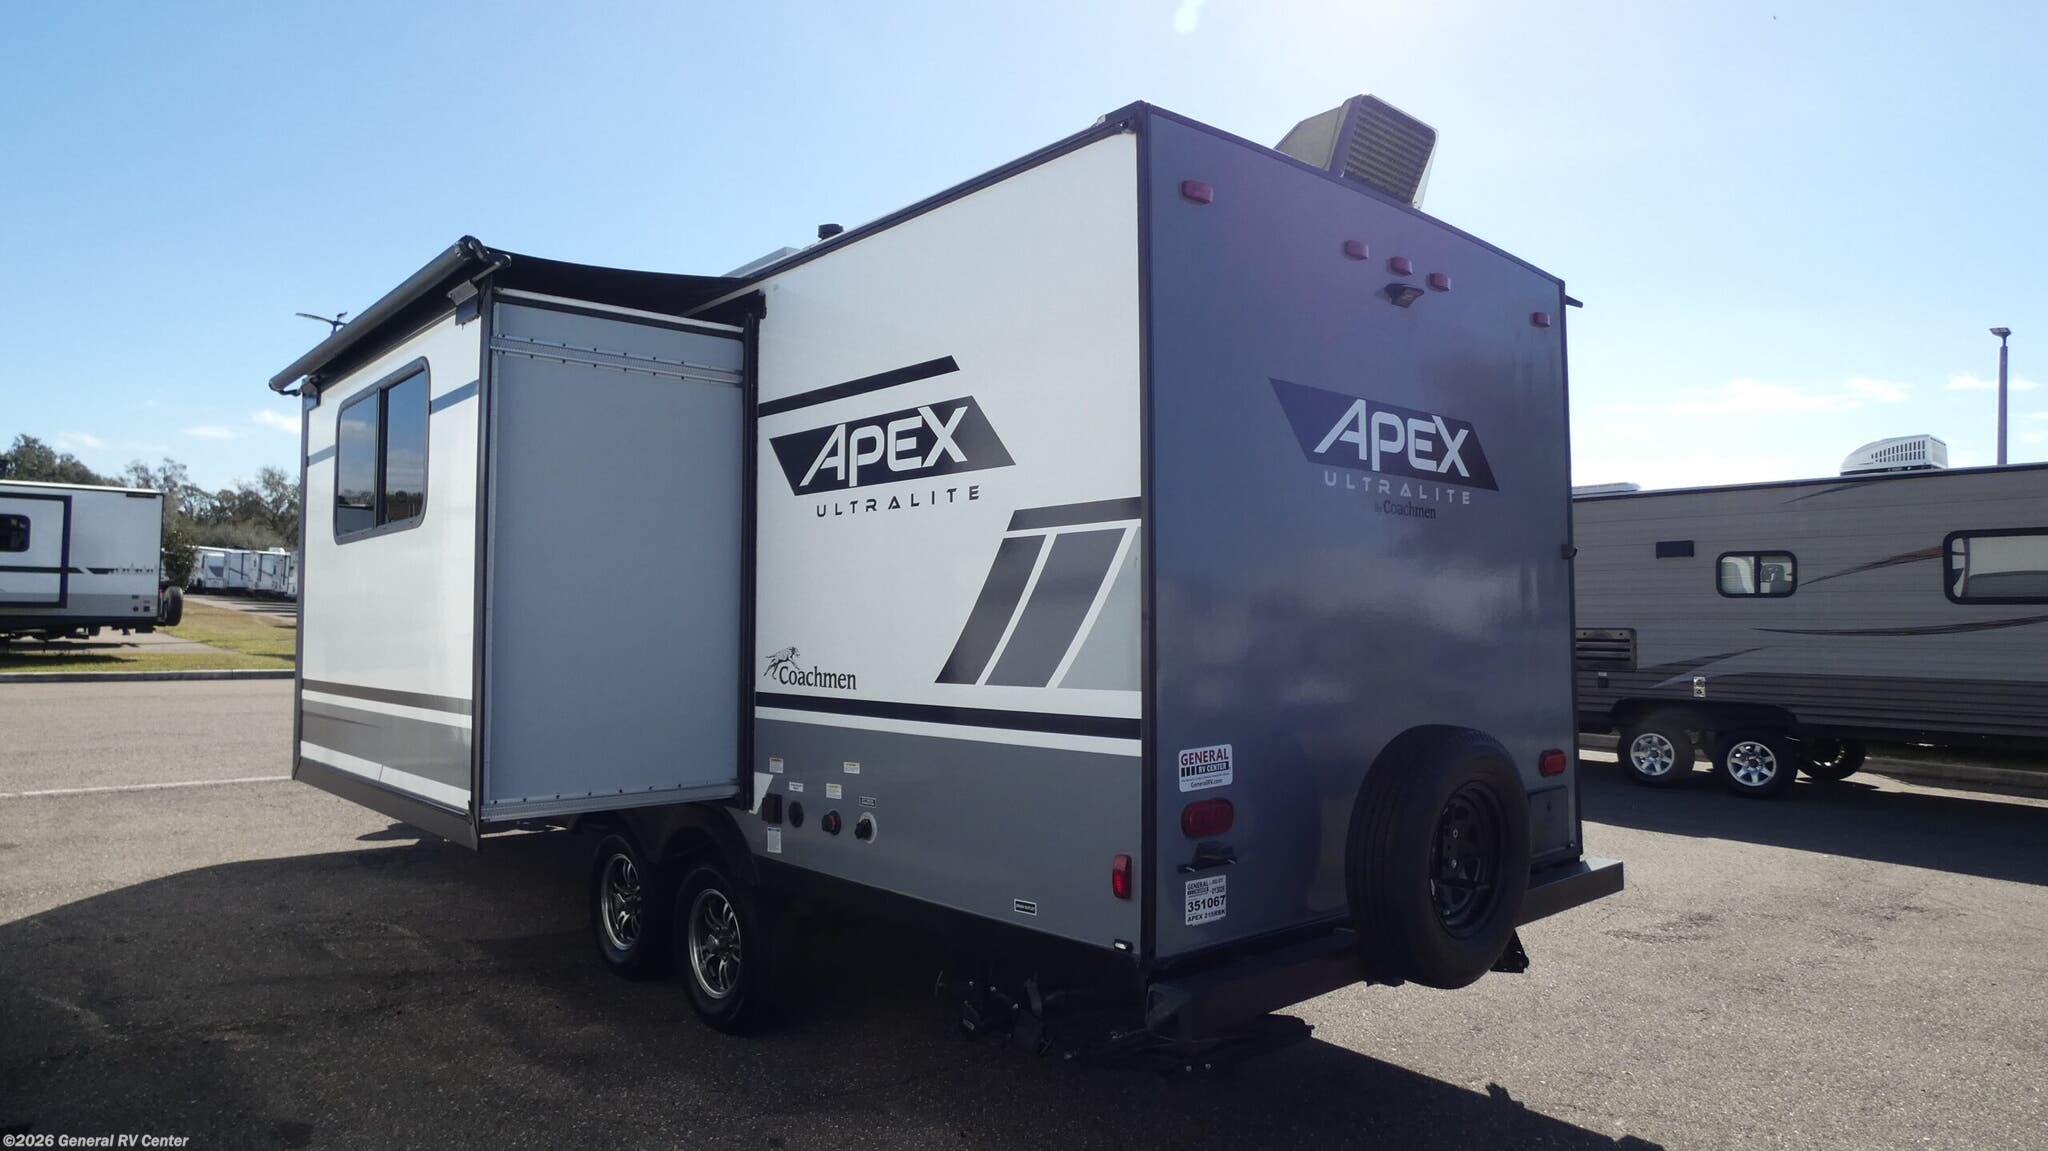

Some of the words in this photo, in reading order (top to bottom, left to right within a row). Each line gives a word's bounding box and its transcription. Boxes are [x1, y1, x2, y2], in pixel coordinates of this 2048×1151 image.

[799, 405, 969, 487] APEX
[1313, 398, 1471, 478] APEX
[816, 485, 980, 517] ULTRALITE
[1324, 470, 1471, 505] ULTRALITE
[1383, 500, 1437, 520] Coachmen
[779, 665, 857, 690] Coachmen
[1181, 748, 1230, 766] GENERAL
[1187, 895, 1226, 912] 351067
